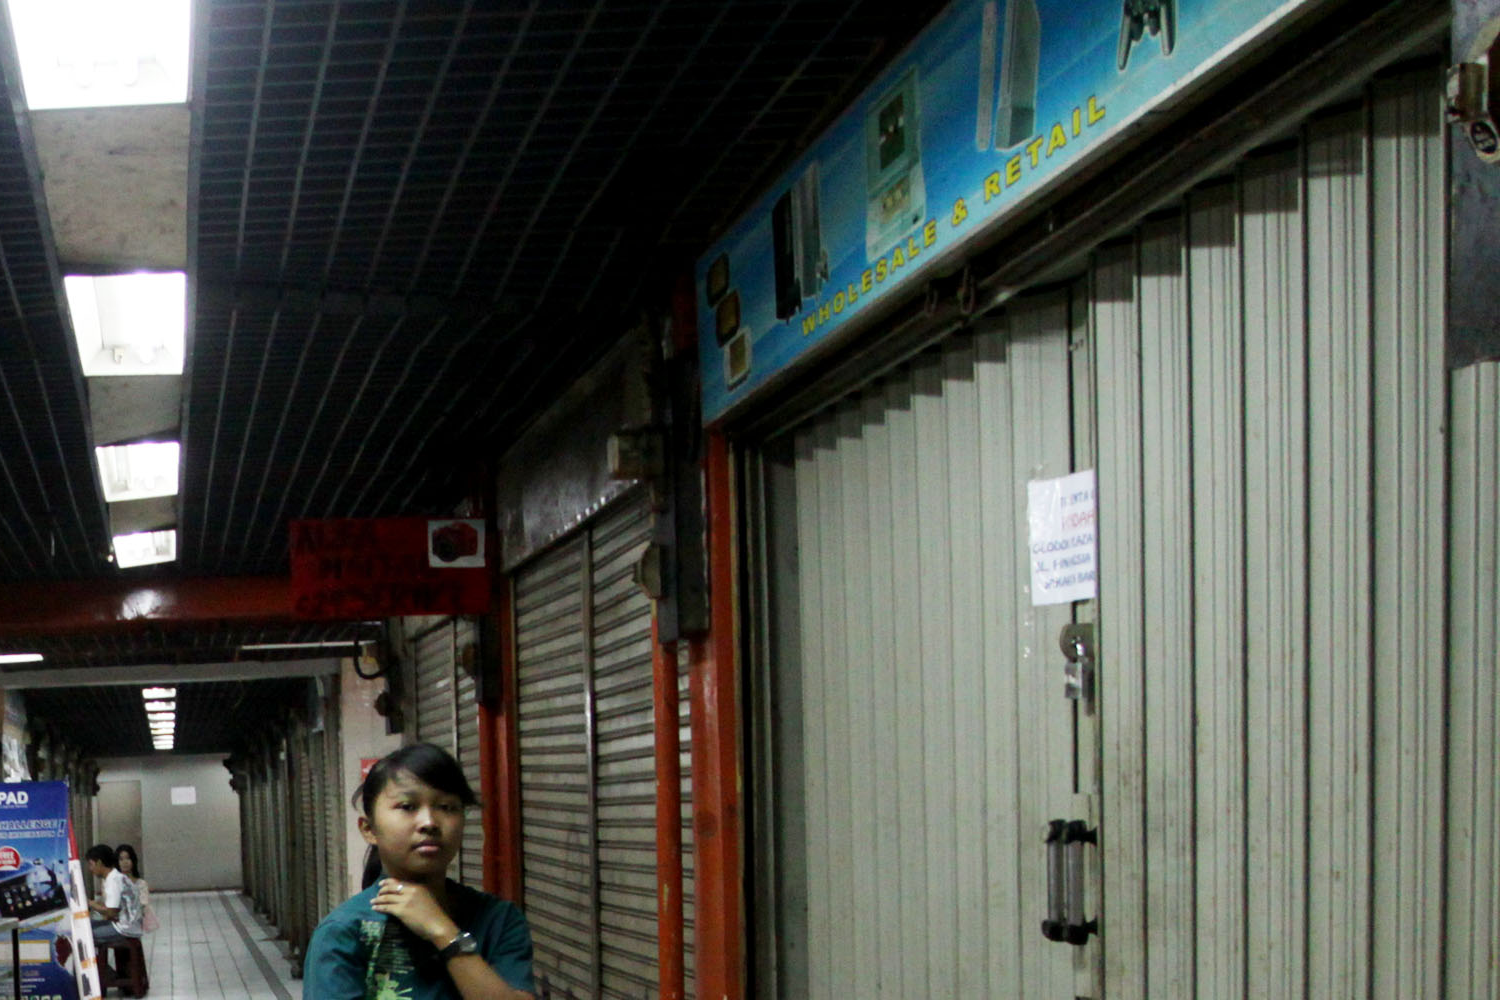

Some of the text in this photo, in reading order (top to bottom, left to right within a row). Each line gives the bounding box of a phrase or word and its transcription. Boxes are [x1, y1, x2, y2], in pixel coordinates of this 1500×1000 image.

[802, 93, 1107, 337] WHOLESALE & RETAIL
